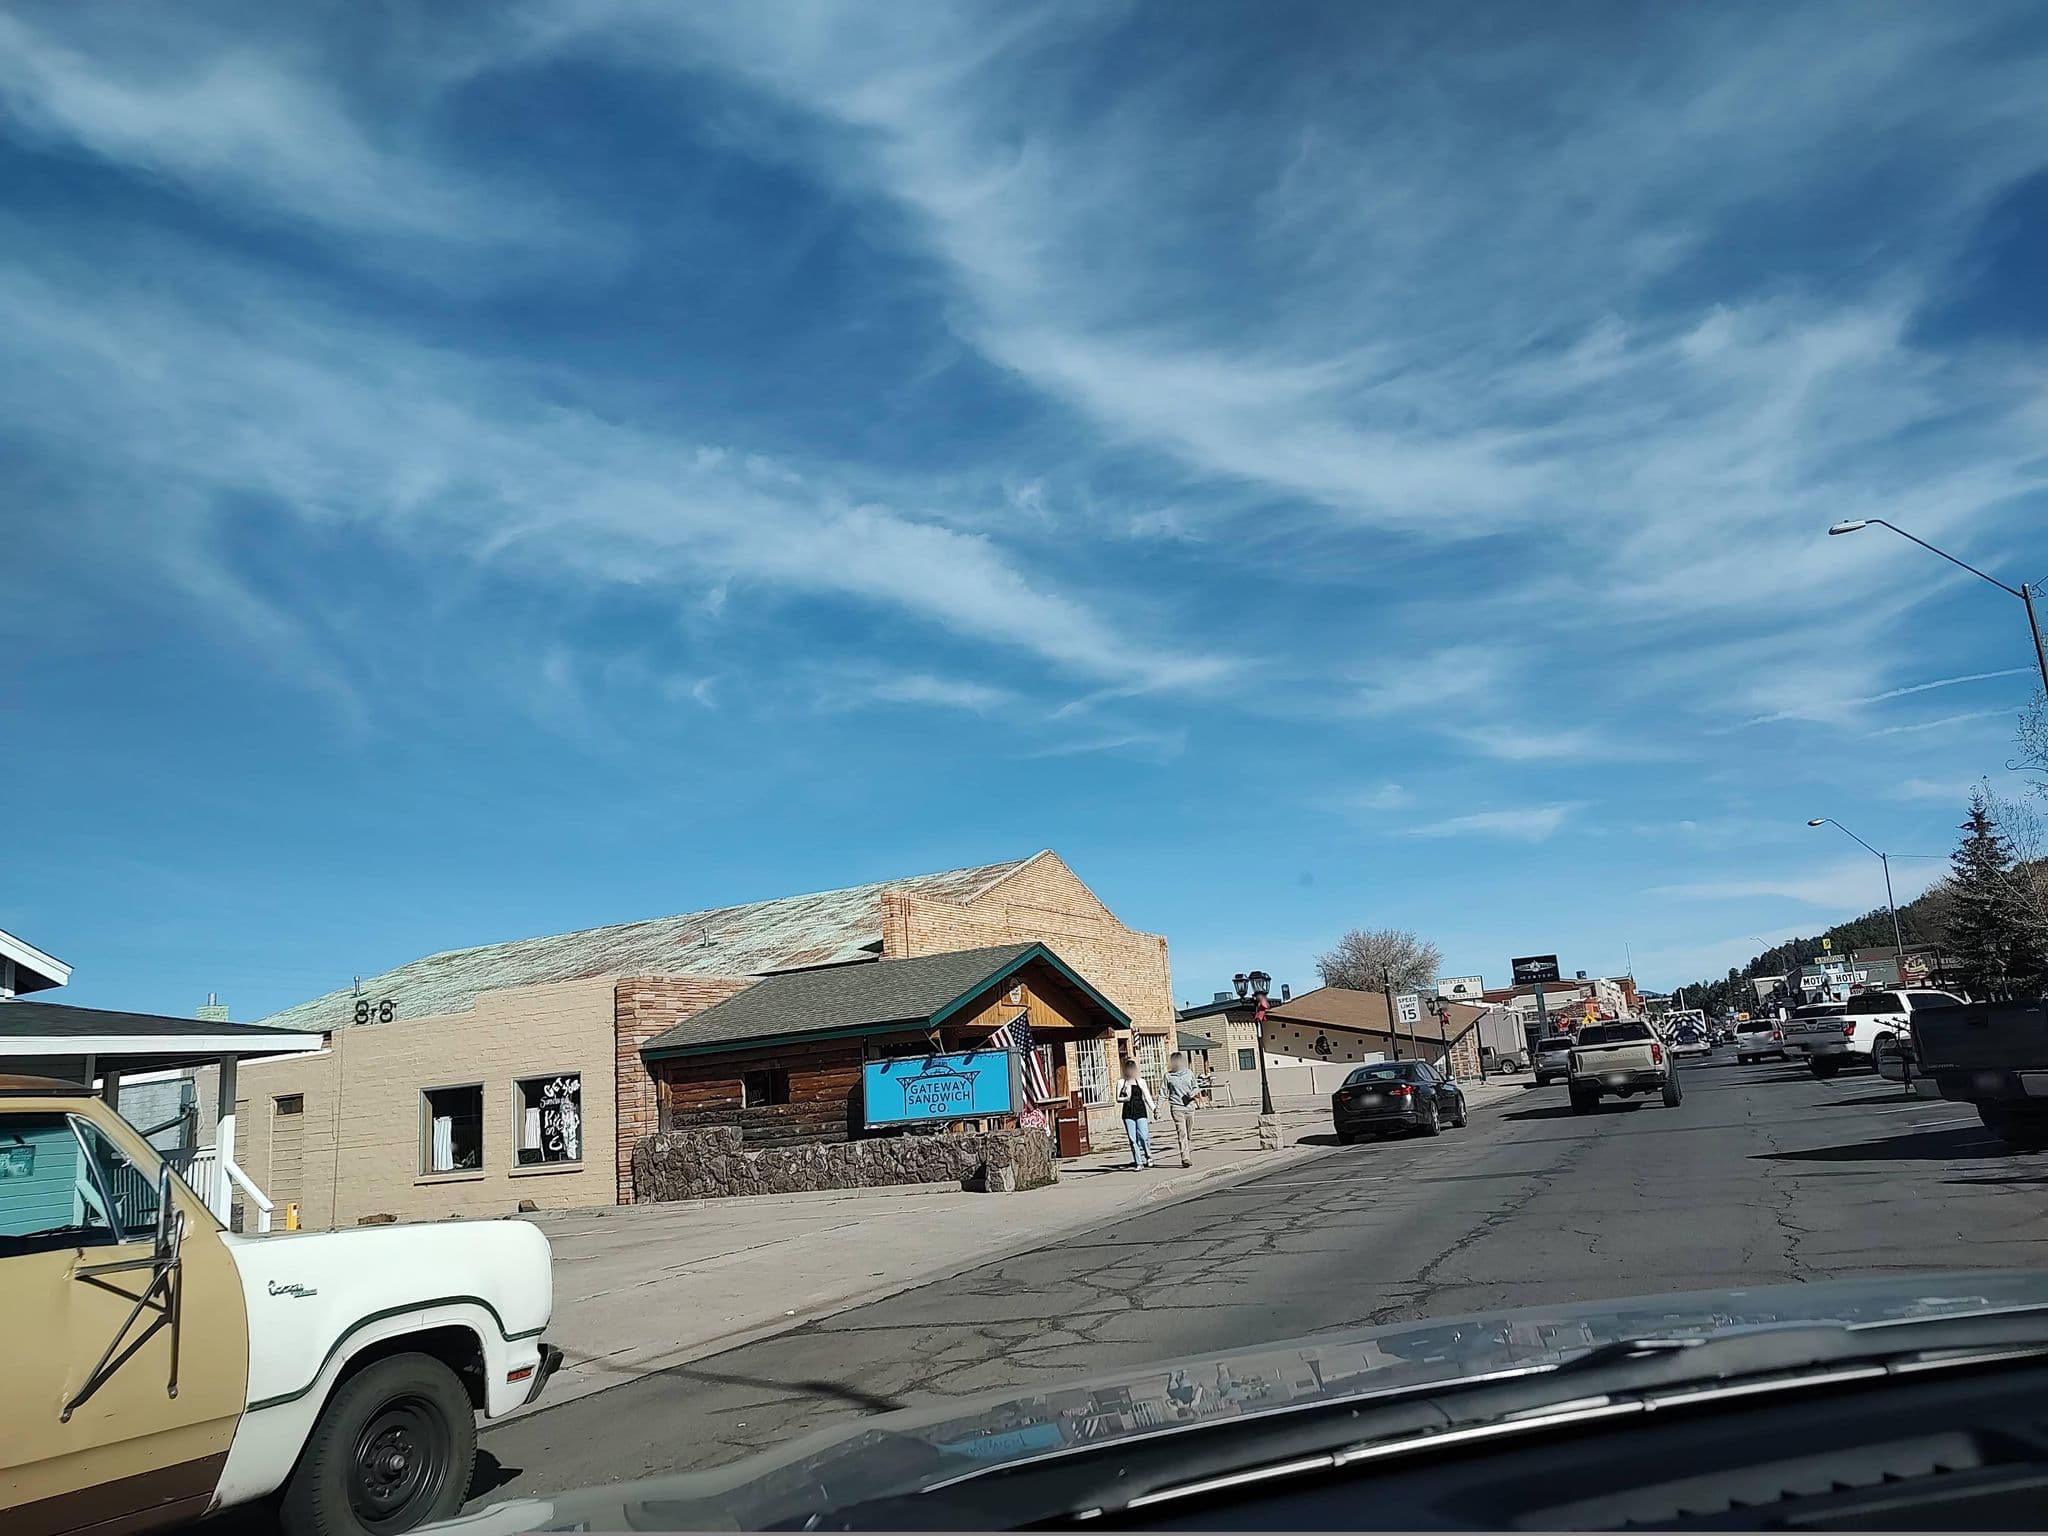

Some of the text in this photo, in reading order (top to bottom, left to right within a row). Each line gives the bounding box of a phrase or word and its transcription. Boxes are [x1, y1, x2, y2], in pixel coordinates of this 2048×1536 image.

[1803, 976, 1825, 986] MOT
[1402, 1009, 1417, 1020] 15
[910, 1081, 966, 1095] GATEWAY
[908, 1090, 970, 1105] SANDWICH
[929, 1103, 950, 1113] CO.
